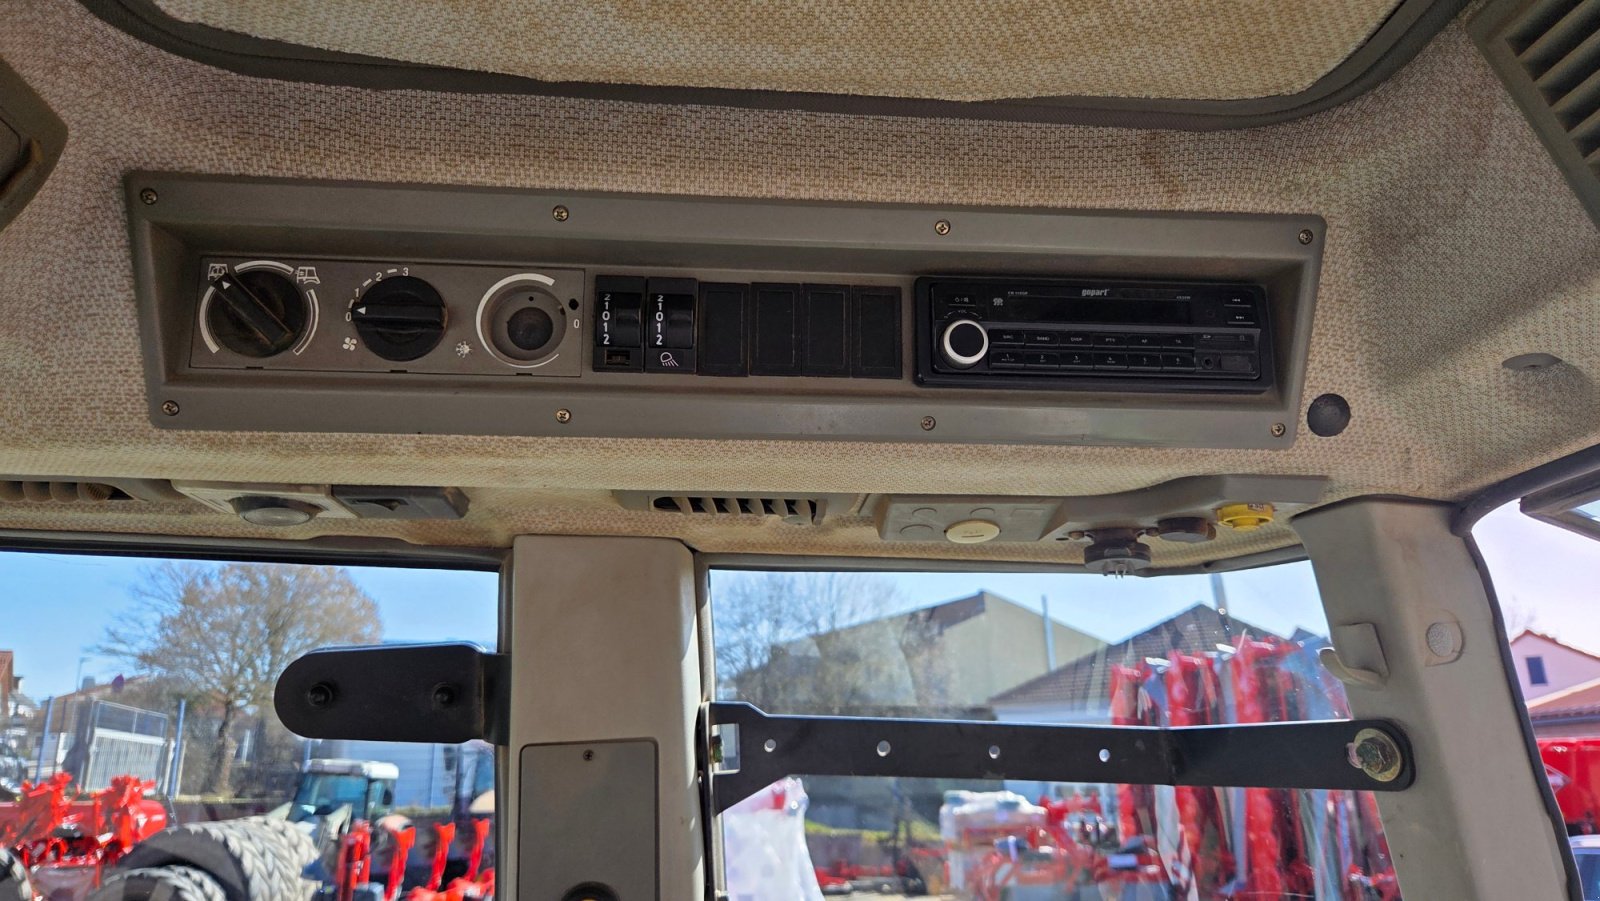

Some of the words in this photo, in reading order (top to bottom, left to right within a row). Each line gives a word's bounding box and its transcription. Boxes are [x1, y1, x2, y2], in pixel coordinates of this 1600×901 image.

[375, 272, 382, 282] 2
[402, 267, 409, 277] 3
[354, 288, 359, 297] 1
[1082, 289, 1108, 297] gopart
[604, 302, 609, 310] 1
[345, 312, 352, 322] 0
[602, 311, 610, 321] 0
[655, 312, 664, 321] 0
[573, 319, 580, 329] 0
[603, 322, 608, 332] 1
[656, 323, 661, 333] 1
[603, 334, 610, 345] 2
[656, 335, 663, 345] 2
